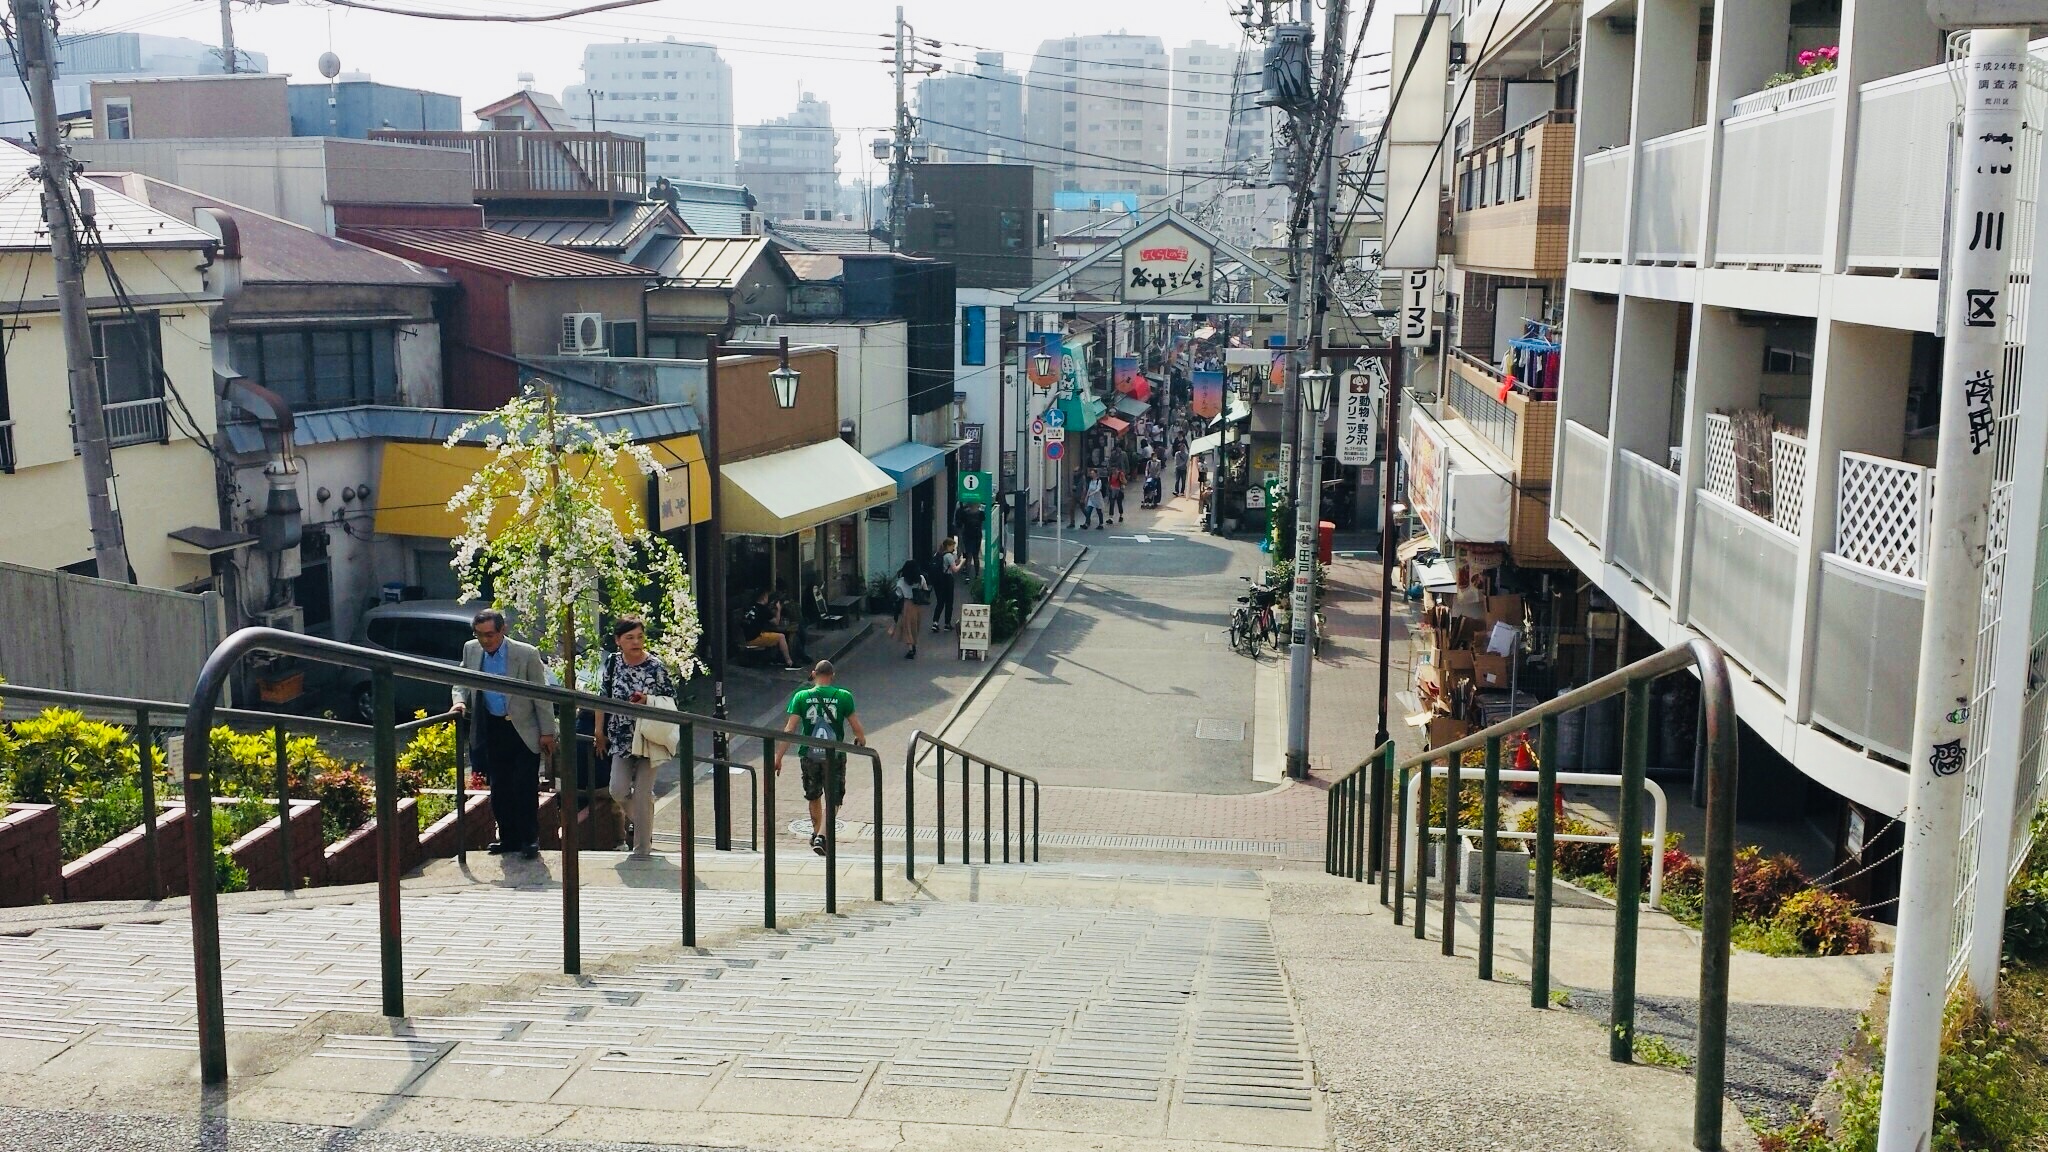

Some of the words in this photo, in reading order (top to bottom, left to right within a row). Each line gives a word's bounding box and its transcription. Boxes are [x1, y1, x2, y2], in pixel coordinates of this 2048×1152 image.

[1978, 79, 2018, 90] 調査済
[1406, 270, 1427, 339] リーマン
[1345, 395, 1358, 445] クリニック
[961, 631, 987, 640] PAPA
